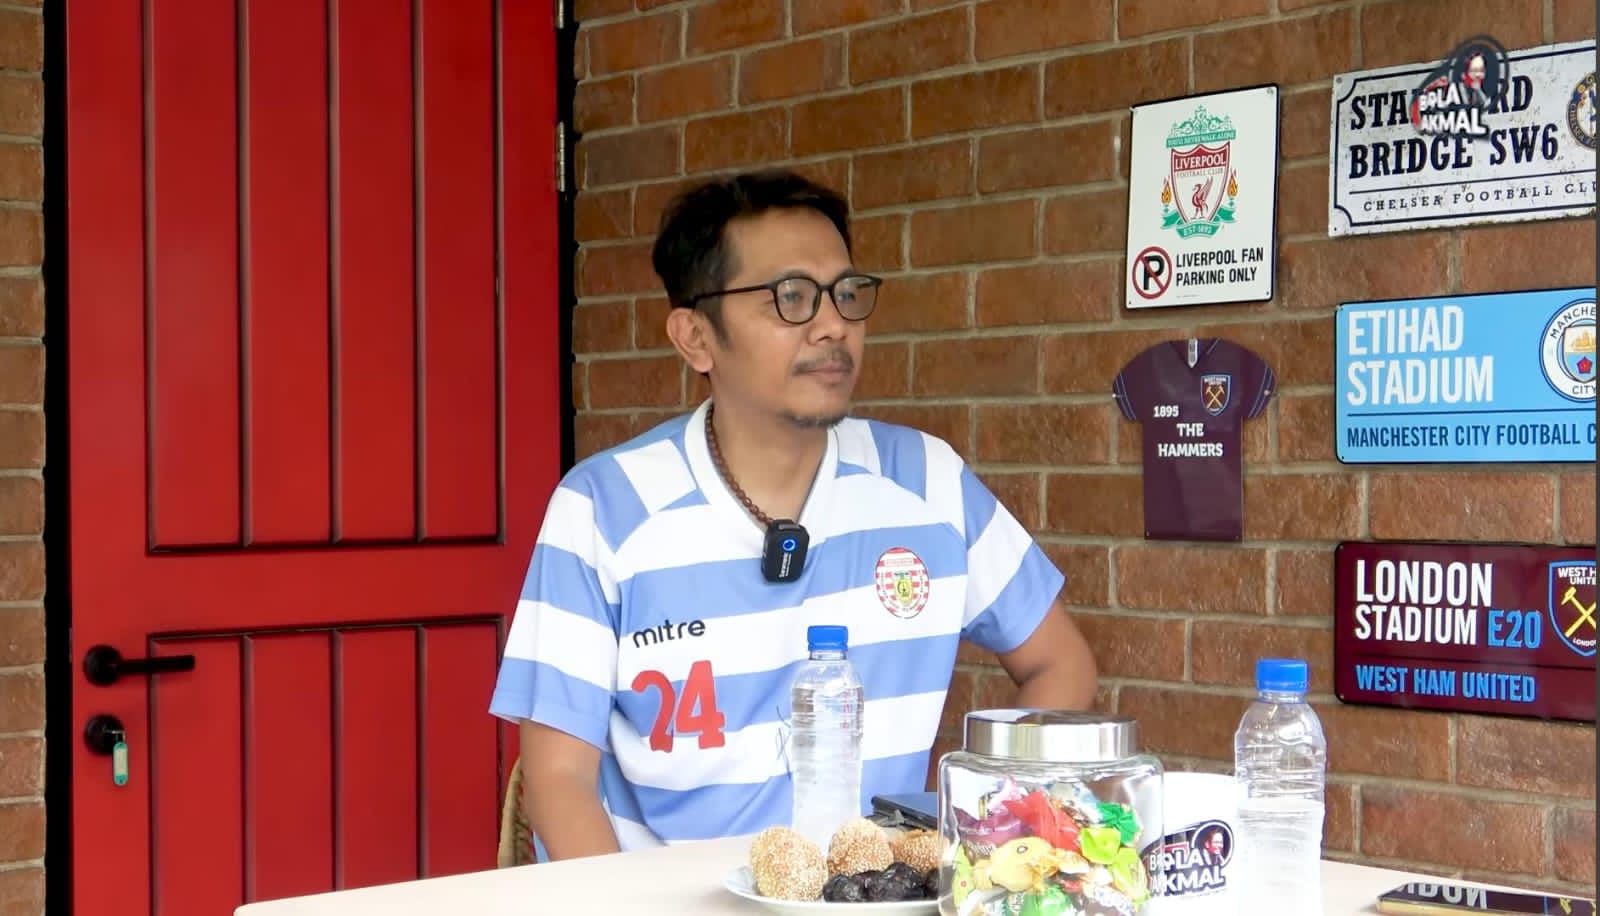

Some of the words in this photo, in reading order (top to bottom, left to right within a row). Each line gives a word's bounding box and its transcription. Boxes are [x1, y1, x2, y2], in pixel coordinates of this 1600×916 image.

[1175, 153, 1226, 170] LIVERPOOL
[1349, 135, 1473, 179] BRIDGE
[1490, 123, 1559, 166] SW6
[1363, 195, 1442, 212] CHELSEA
[1453, 185, 1553, 205] FOOTBALL
[1176, 251, 1237, 268] LIVERPOOL
[1241, 247, 1264, 263] FAN
[1176, 270, 1225, 287] PARKING
[1229, 266, 1258, 283] ONLY
[1348, 305, 1464, 355] ETIHAD
[1347, 356, 1494, 406] STADIUM
[1153, 405, 1179, 418] 1895
[1176, 423, 1204, 437] THE
[1347, 425, 1449, 448] MANCHESTER
[1455, 425, 1491, 446] CITY
[1496, 423, 1580, 445] FOOTBALL
[1158, 443, 1224, 457] HAMMERS
[1356, 559, 1493, 607] LONDON
[1558, 567, 1587, 578] WEST
[632, 619, 706, 649] mitre
[1355, 605, 1477, 646] STADIUM
[1487, 610, 1542, 649] E20
[1355, 665, 1408, 693] WEST
[1414, 669, 1456, 697] HAM
[1462, 672, 1537, 703] UNITED
[631, 660, 726, 754] 24
